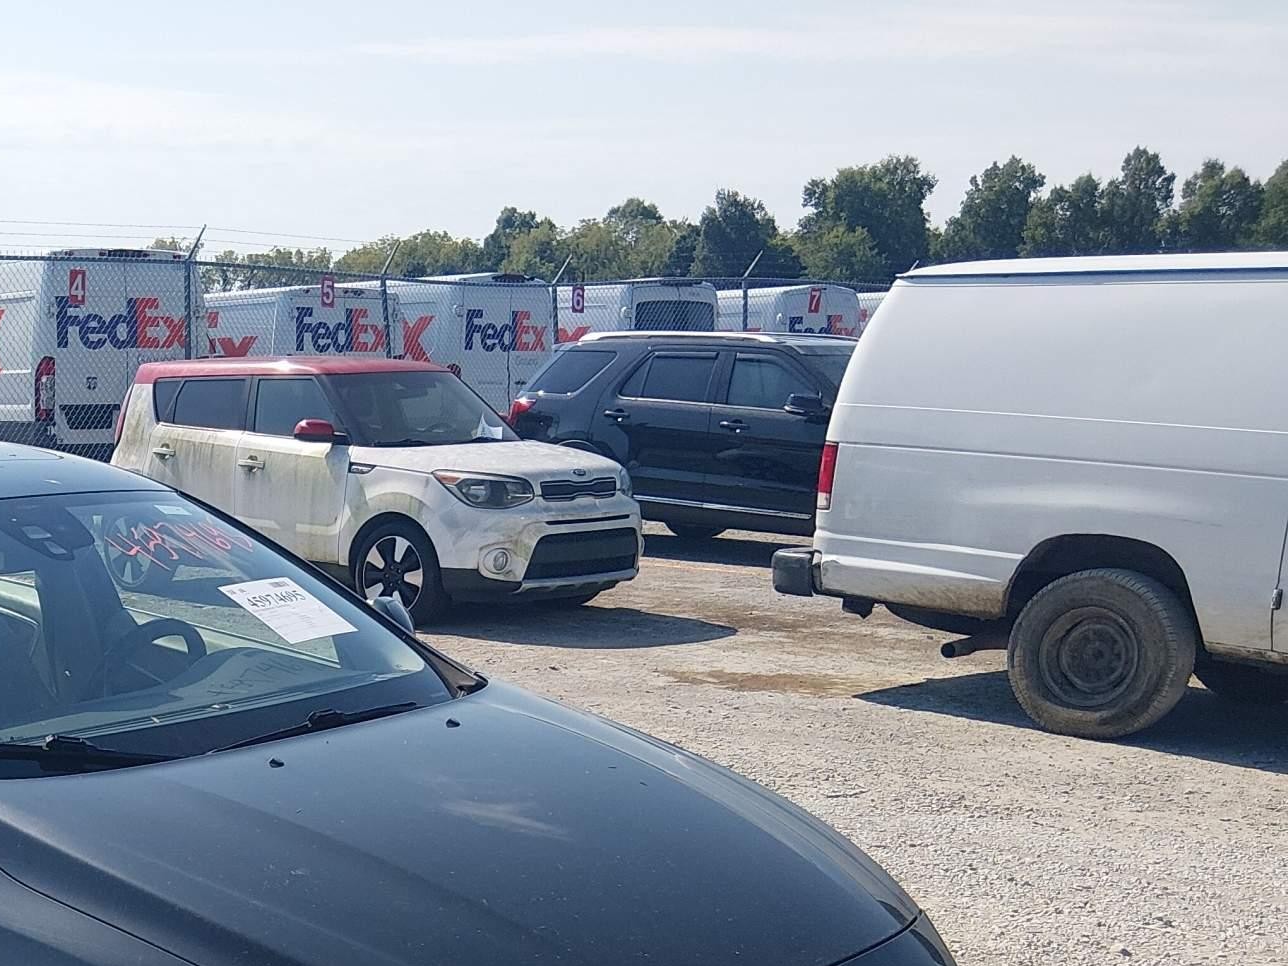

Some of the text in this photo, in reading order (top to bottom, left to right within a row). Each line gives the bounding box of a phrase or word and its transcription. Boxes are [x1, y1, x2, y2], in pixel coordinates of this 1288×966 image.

[70, 273, 85, 299] 4
[322, 281, 334, 304] 5
[573, 288, 583, 310] 6
[811, 290, 821, 312] 7
[465, 309, 548, 352] FedEx
[247, 590, 306, 608] 45974695
